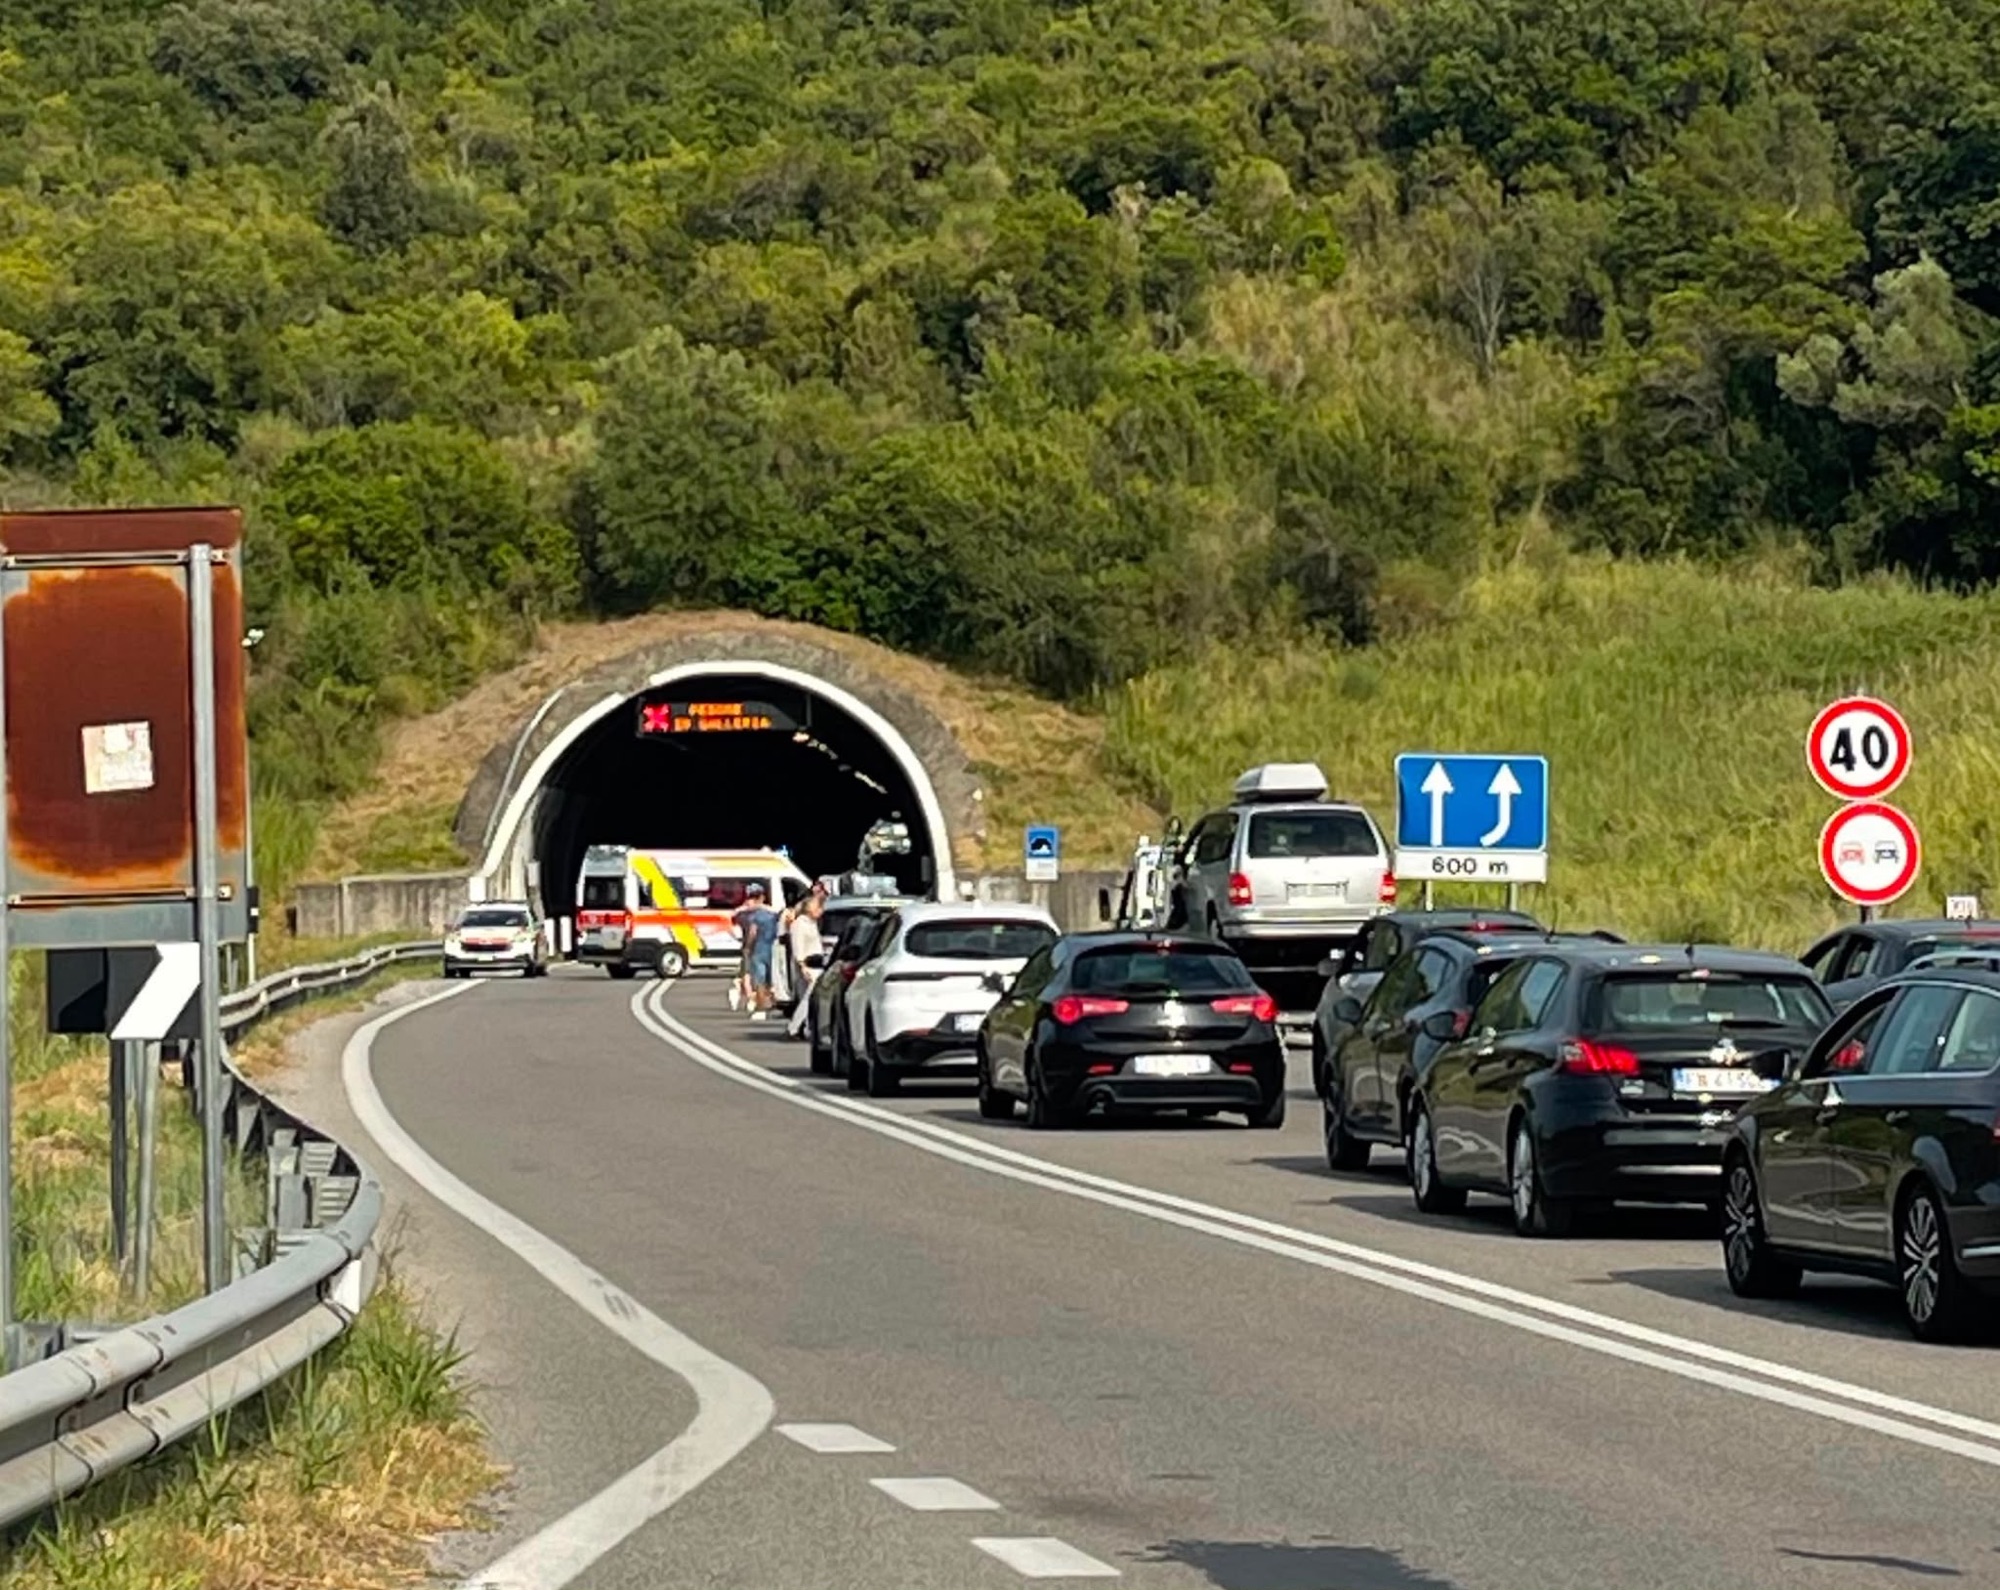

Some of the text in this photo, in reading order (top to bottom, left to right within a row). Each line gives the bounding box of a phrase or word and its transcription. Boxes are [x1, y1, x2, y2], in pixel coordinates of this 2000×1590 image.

[1829, 725, 1890, 772] 40
[1432, 856, 1509, 875] 600 m
